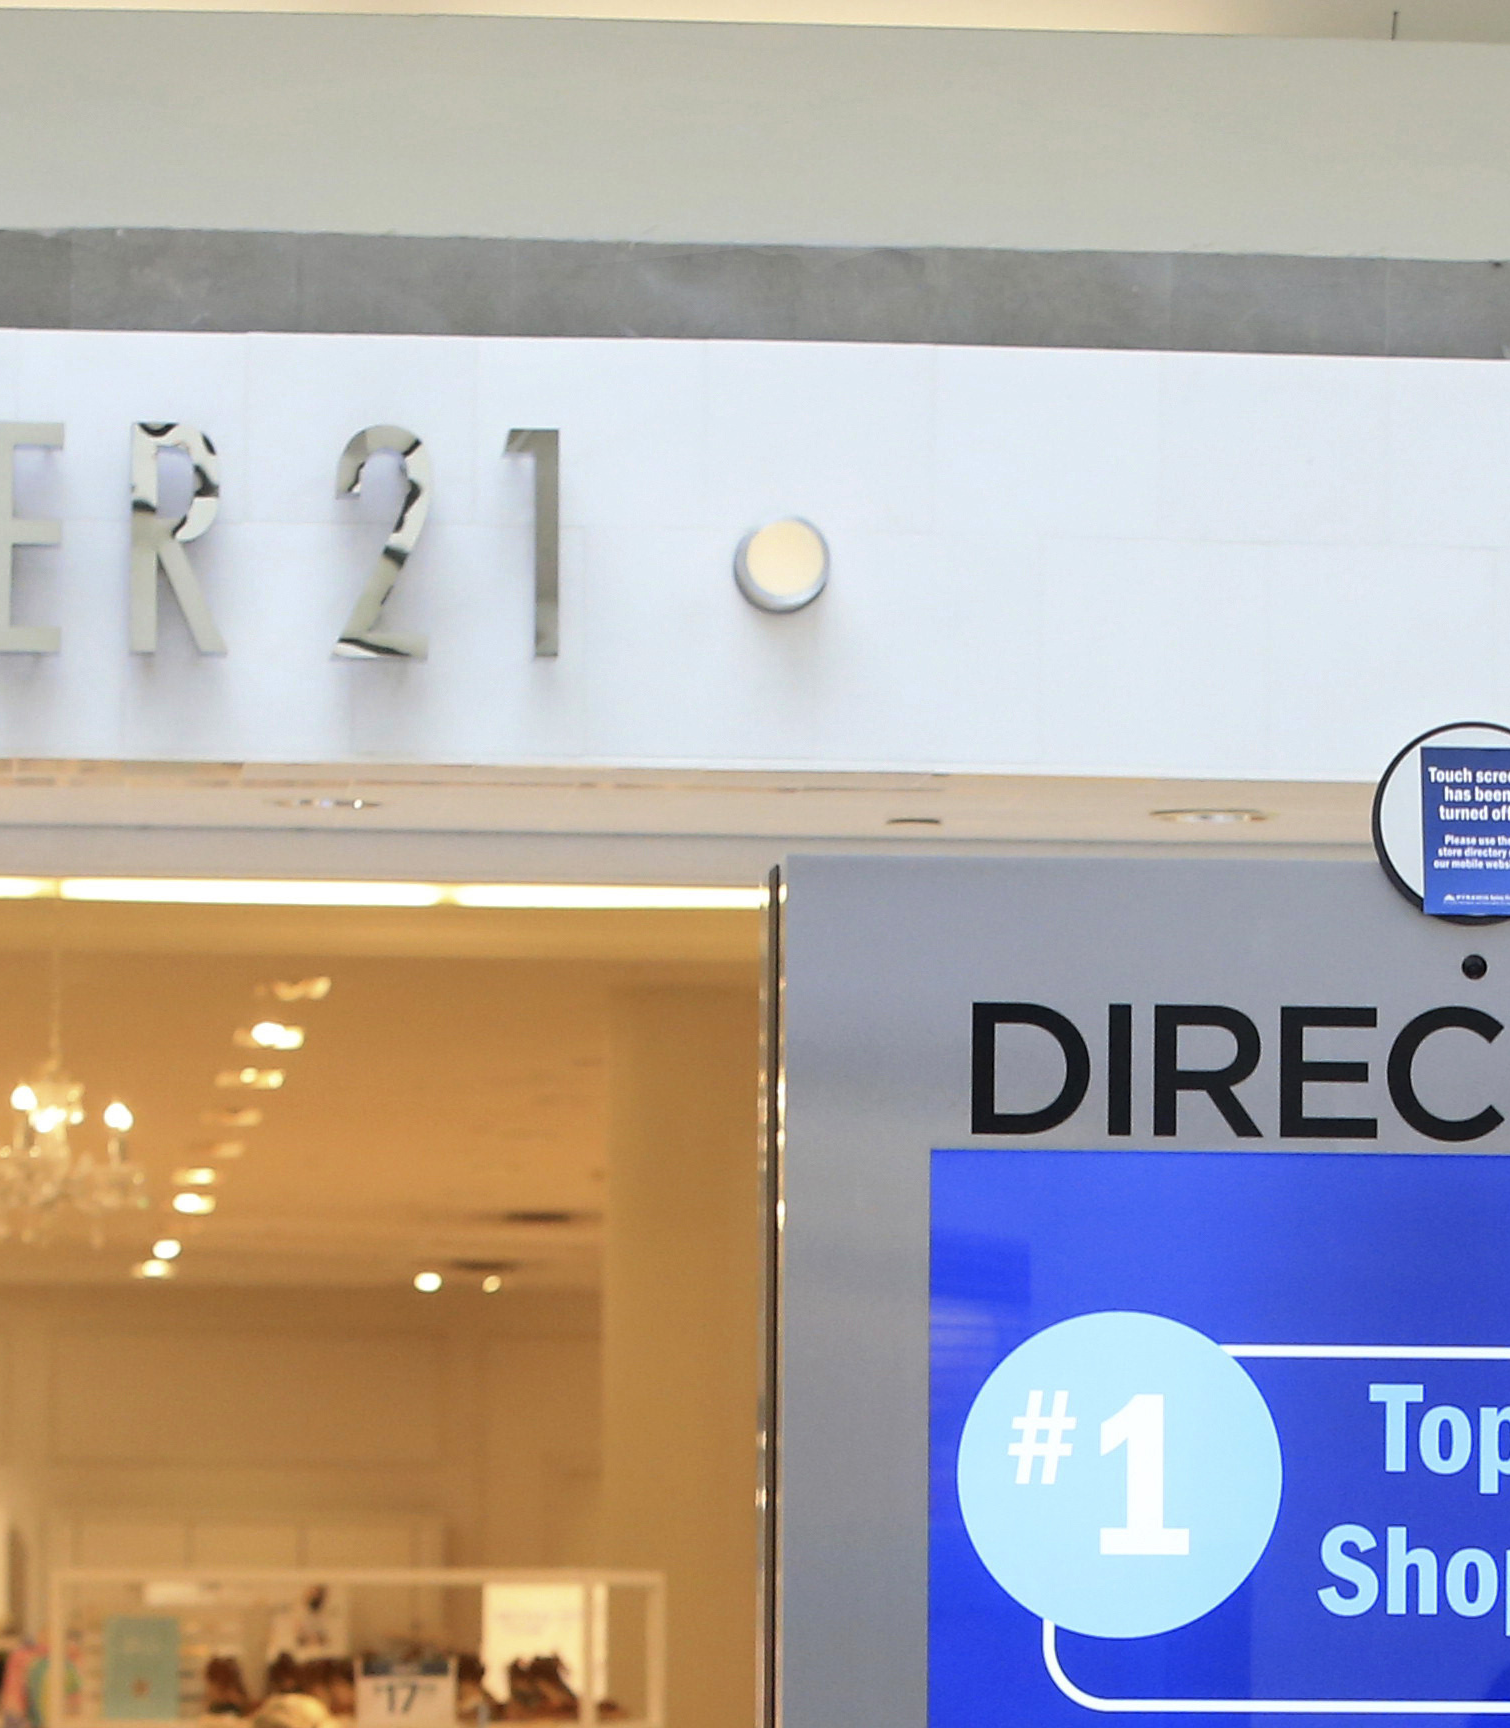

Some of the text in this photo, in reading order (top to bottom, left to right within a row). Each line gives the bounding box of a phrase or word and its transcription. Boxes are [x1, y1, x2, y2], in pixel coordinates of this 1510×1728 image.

[334, 424, 562, 662] 21
[1428, 767, 1472, 782] Touch
[1445, 786, 1510, 801] has been
[1440, 805, 1488, 820] turned
[1445, 834, 1476, 845] Please
[1478, 837, 1495, 845] use
[1438, 847, 1462, 856] store
[1465, 847, 1506, 859] directory
[1434, 860, 1449, 868] our
[1451, 859, 1483, 868] mobile
[1008, 1390, 1189, 1555] #1
